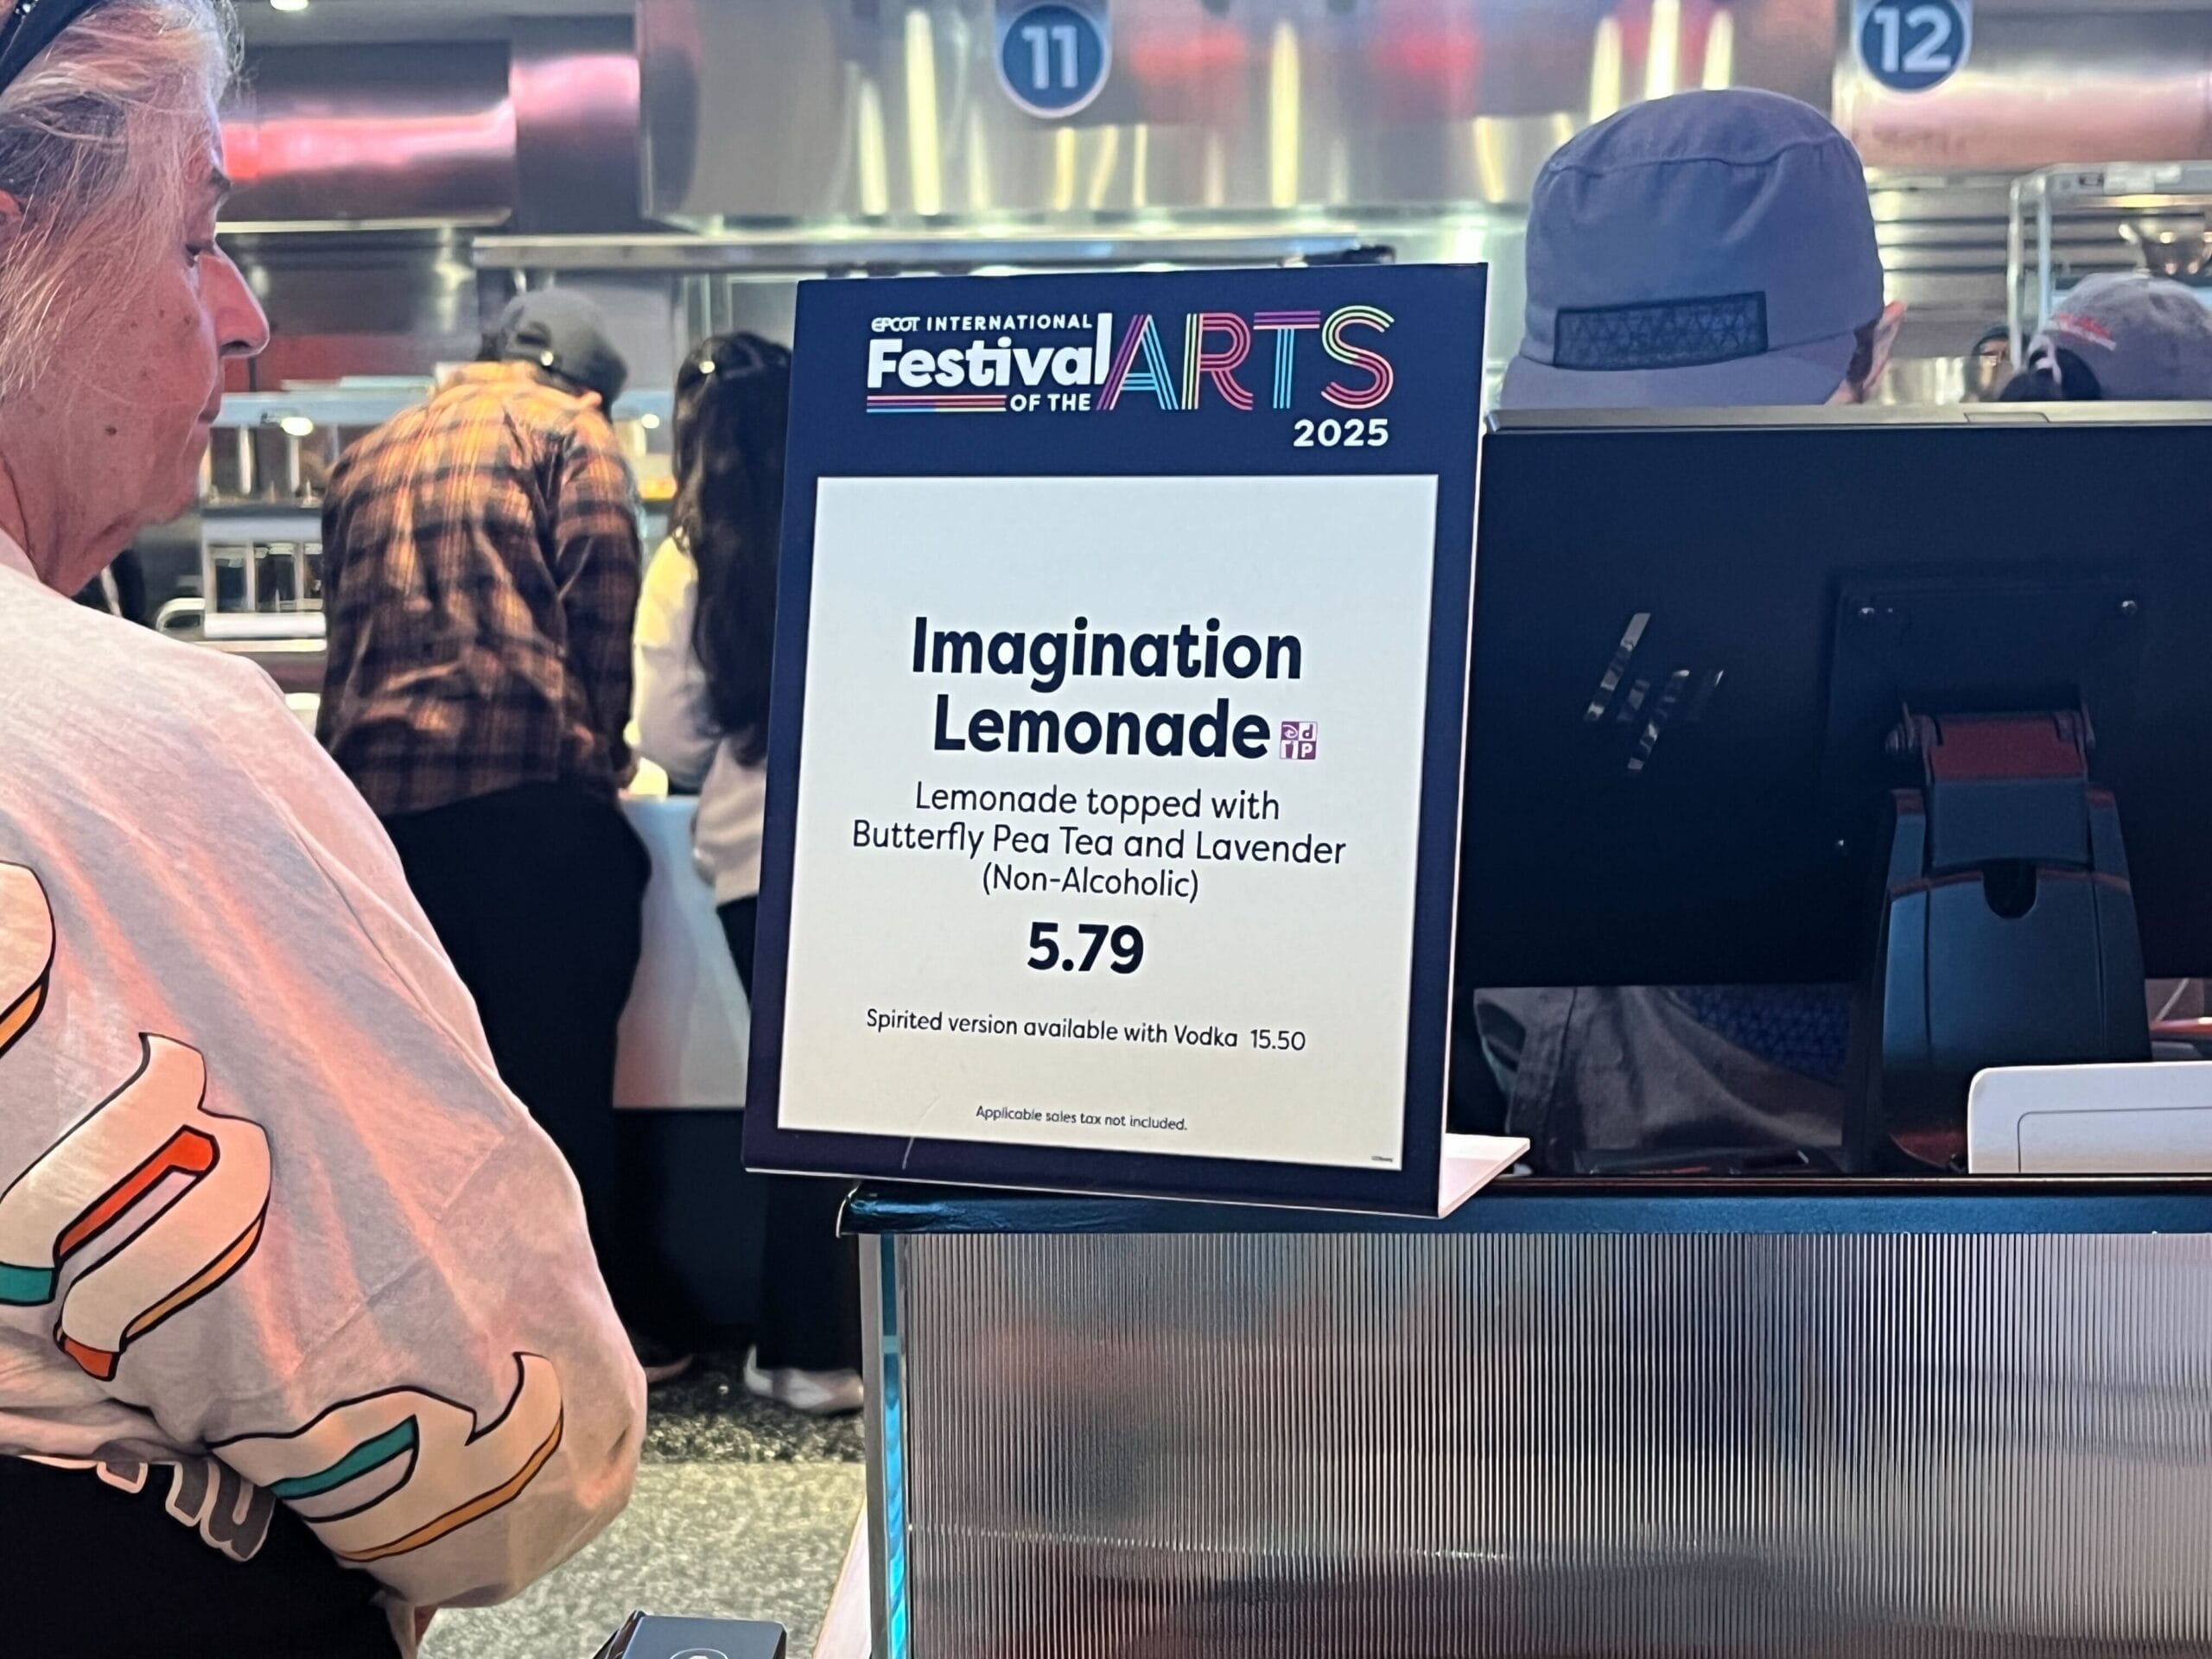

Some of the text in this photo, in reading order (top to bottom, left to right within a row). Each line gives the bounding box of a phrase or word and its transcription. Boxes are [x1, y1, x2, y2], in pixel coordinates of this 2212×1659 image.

[1022, 26, 1078, 89] 11
[1873, 6, 1953, 73] 12
[871, 315, 1092, 332] EPCOT INTERNATIONAL
[867, 313, 1113, 388] Festival
[1096, 305, 1395, 410] ARTS
[1010, 392, 1091, 412] OF THE
[1294, 419, 1389, 447] 2025
[912, 616, 1302, 693] Imagination
[934, 694, 1270, 759] Lemonade
[916, 781, 1280, 824] Lemonade topped with
[853, 819, 1347, 865] Butterfly Pea Tea and Lavender
[982, 861, 1198, 904] (Non-Alcoholic)
[1027, 922, 1144, 974] 5.79
[866, 1008, 1306, 1052] Spirited version available with Vodka 15.50
[975, 1105, 1188, 1131] Applicable sales tax not included.
